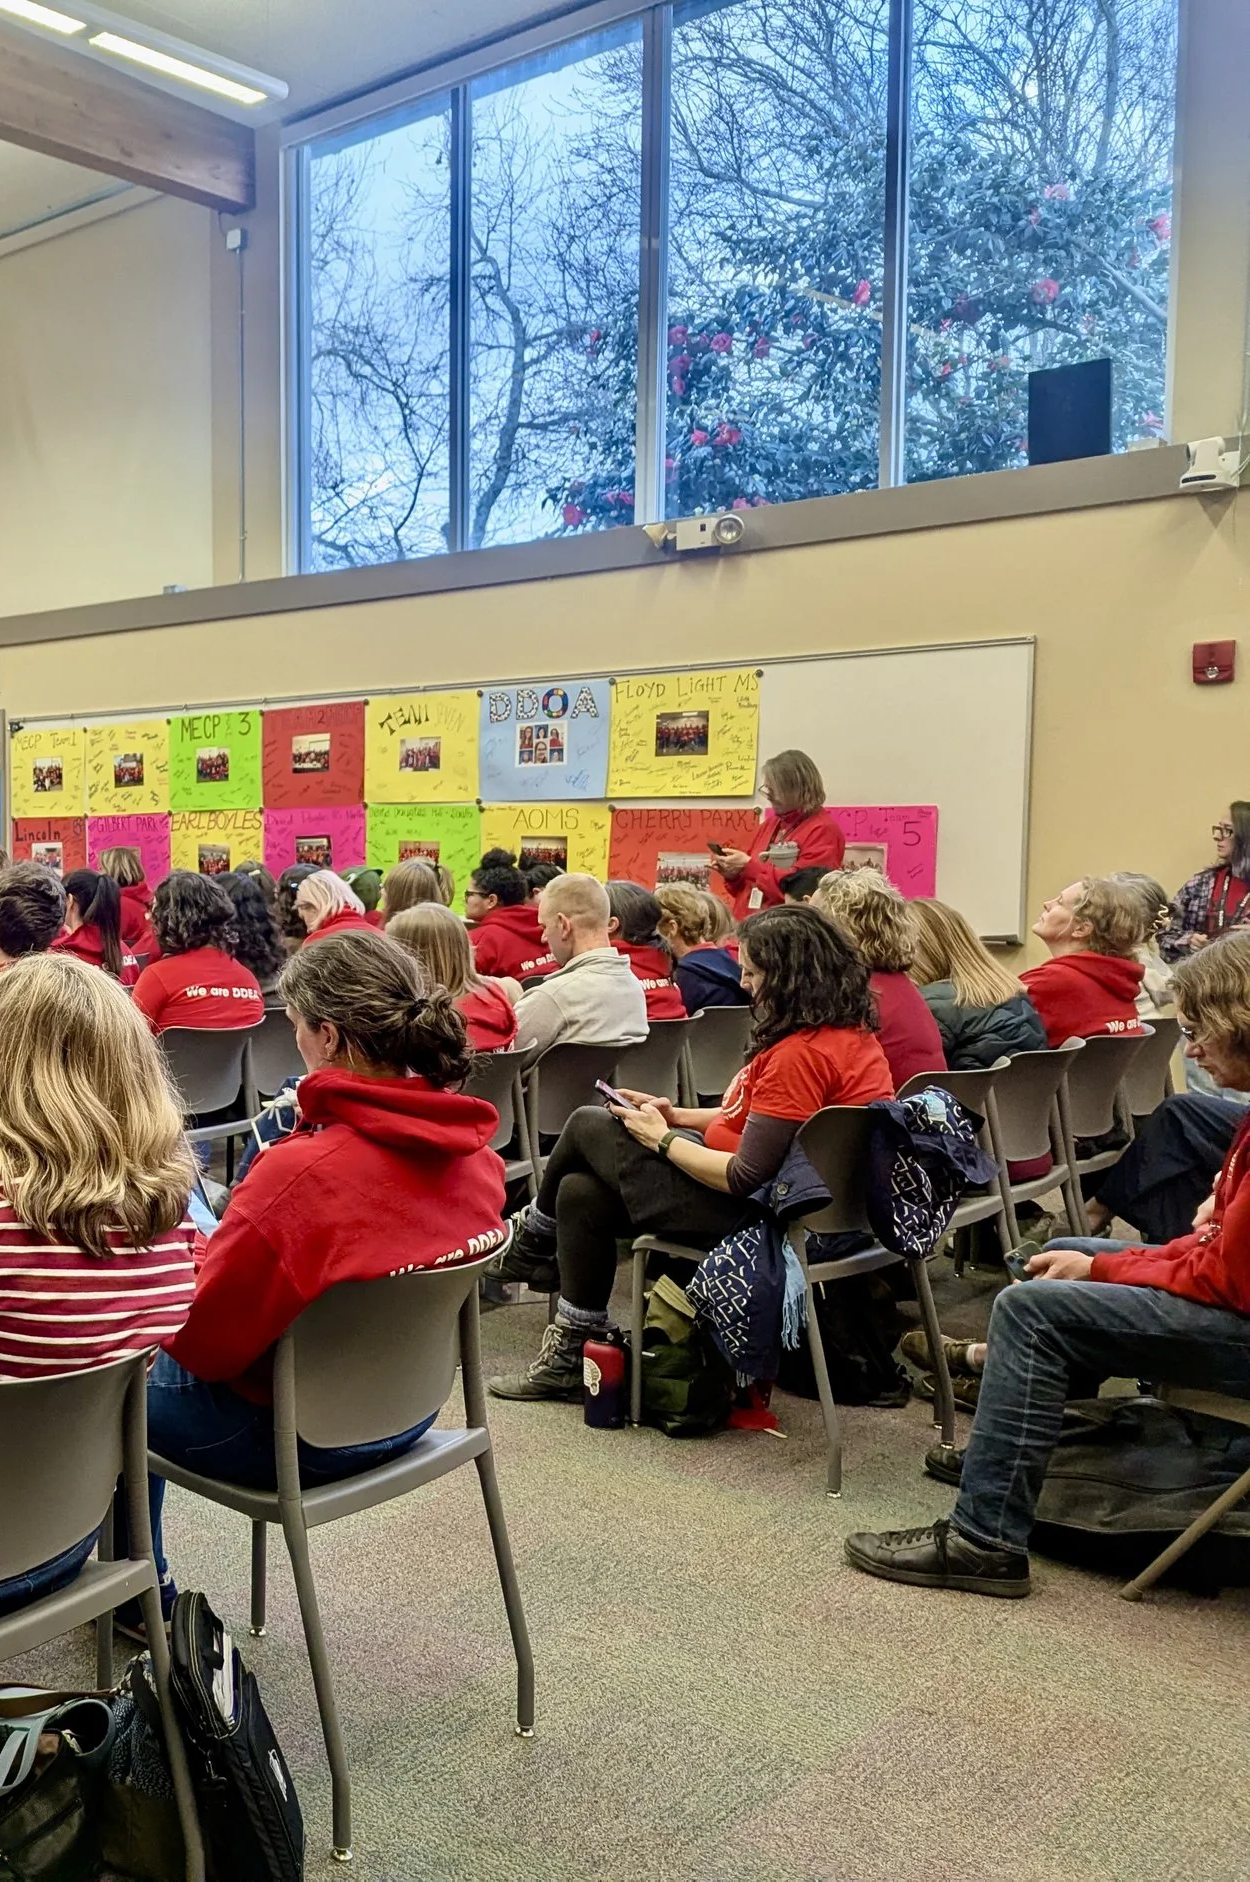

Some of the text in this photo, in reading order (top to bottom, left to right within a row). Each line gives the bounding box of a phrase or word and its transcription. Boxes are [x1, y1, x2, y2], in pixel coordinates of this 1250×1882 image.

[614, 680, 666, 703] FLOYD
[734, 672, 759, 693] MS
[489, 687, 599, 724] DDOA
[181, 714, 221, 742] MECP
[238, 712, 251, 736] 3
[15, 733, 42, 752] MECP
[96, 816, 159, 833] GILBERT PARK
[170, 810, 262, 832] EARL BOYLES
[512, 807, 579, 830] AOMS
[615, 809, 692, 831] CHERRY
[14, 820, 61, 842] Lincoln
[902, 821, 922, 846] 5
[520, 960, 535, 971] We
[185, 985, 260, 999] We are DDEA
[639, 978, 656, 991] We
[1105, 1020, 1125, 1033] We
[467, 1228, 505, 1256] DDEA
